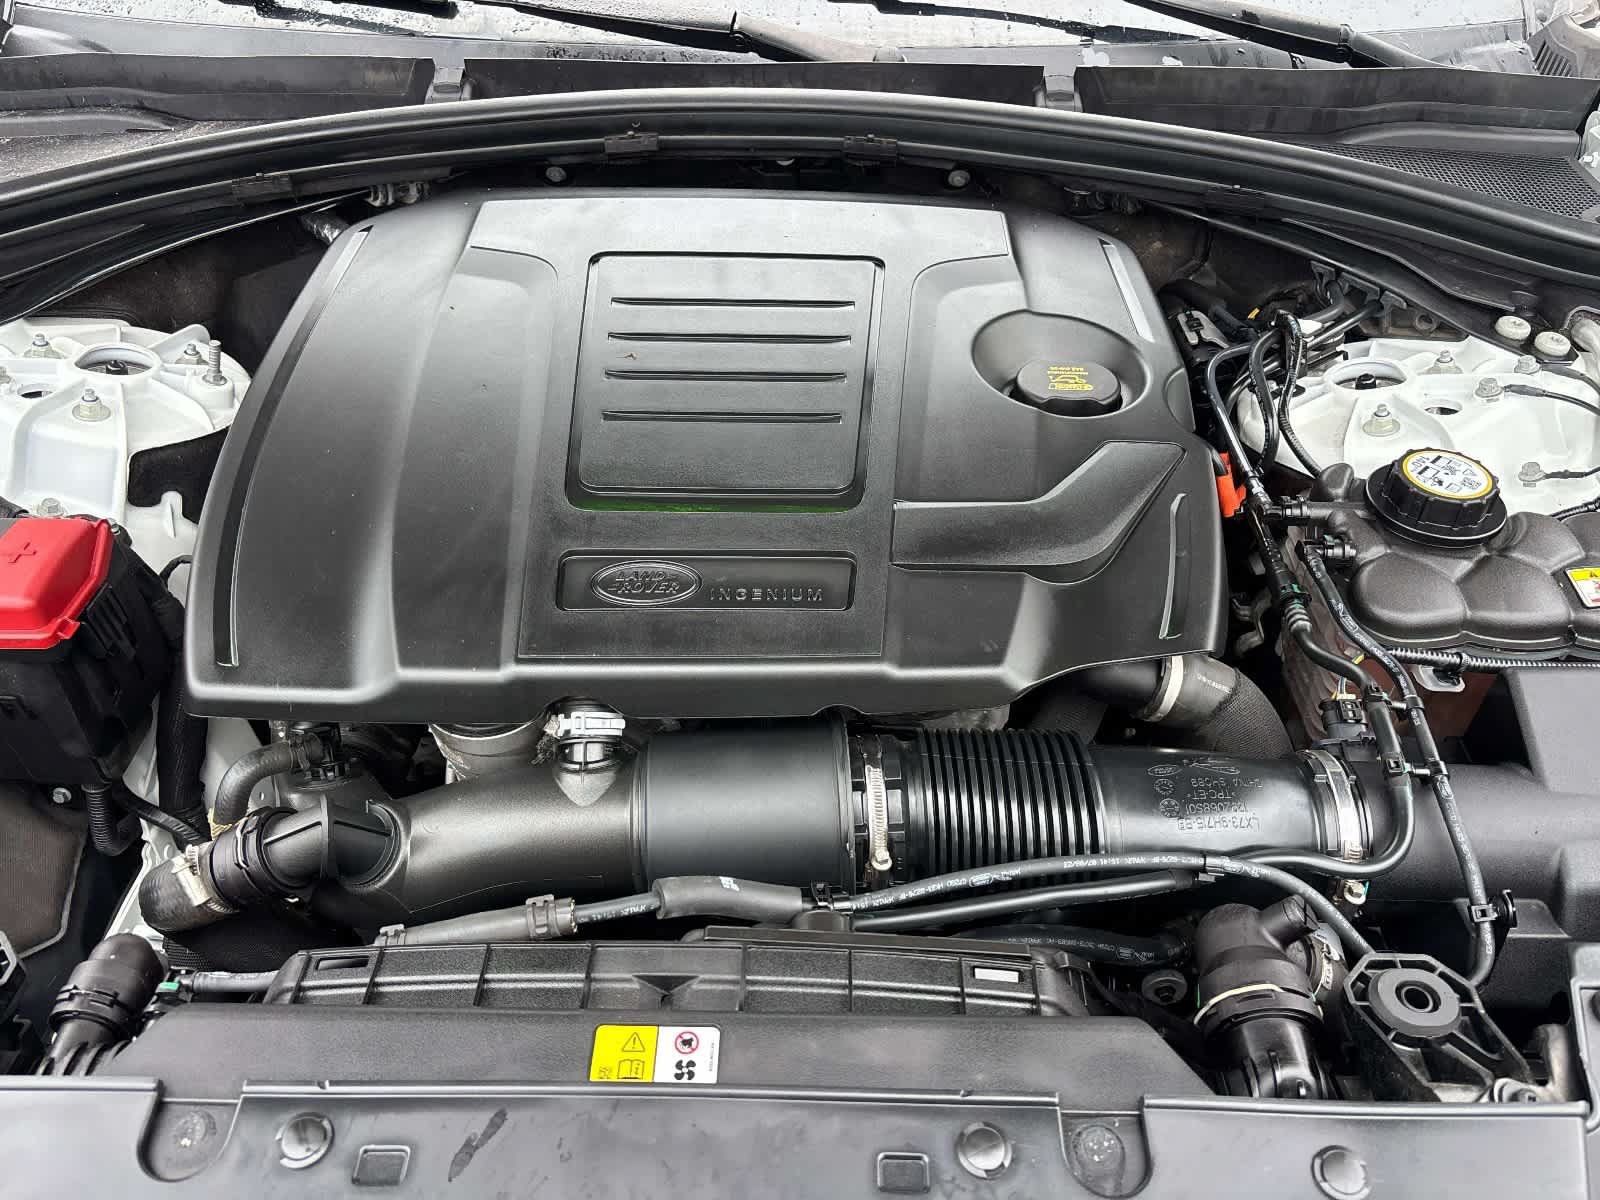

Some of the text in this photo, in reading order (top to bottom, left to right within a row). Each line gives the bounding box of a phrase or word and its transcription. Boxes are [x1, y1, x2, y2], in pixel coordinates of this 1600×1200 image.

[615, 571, 665, 581] LAND
[617, 582, 680, 594] ROVER
[710, 588, 822, 601] INGENIUM
